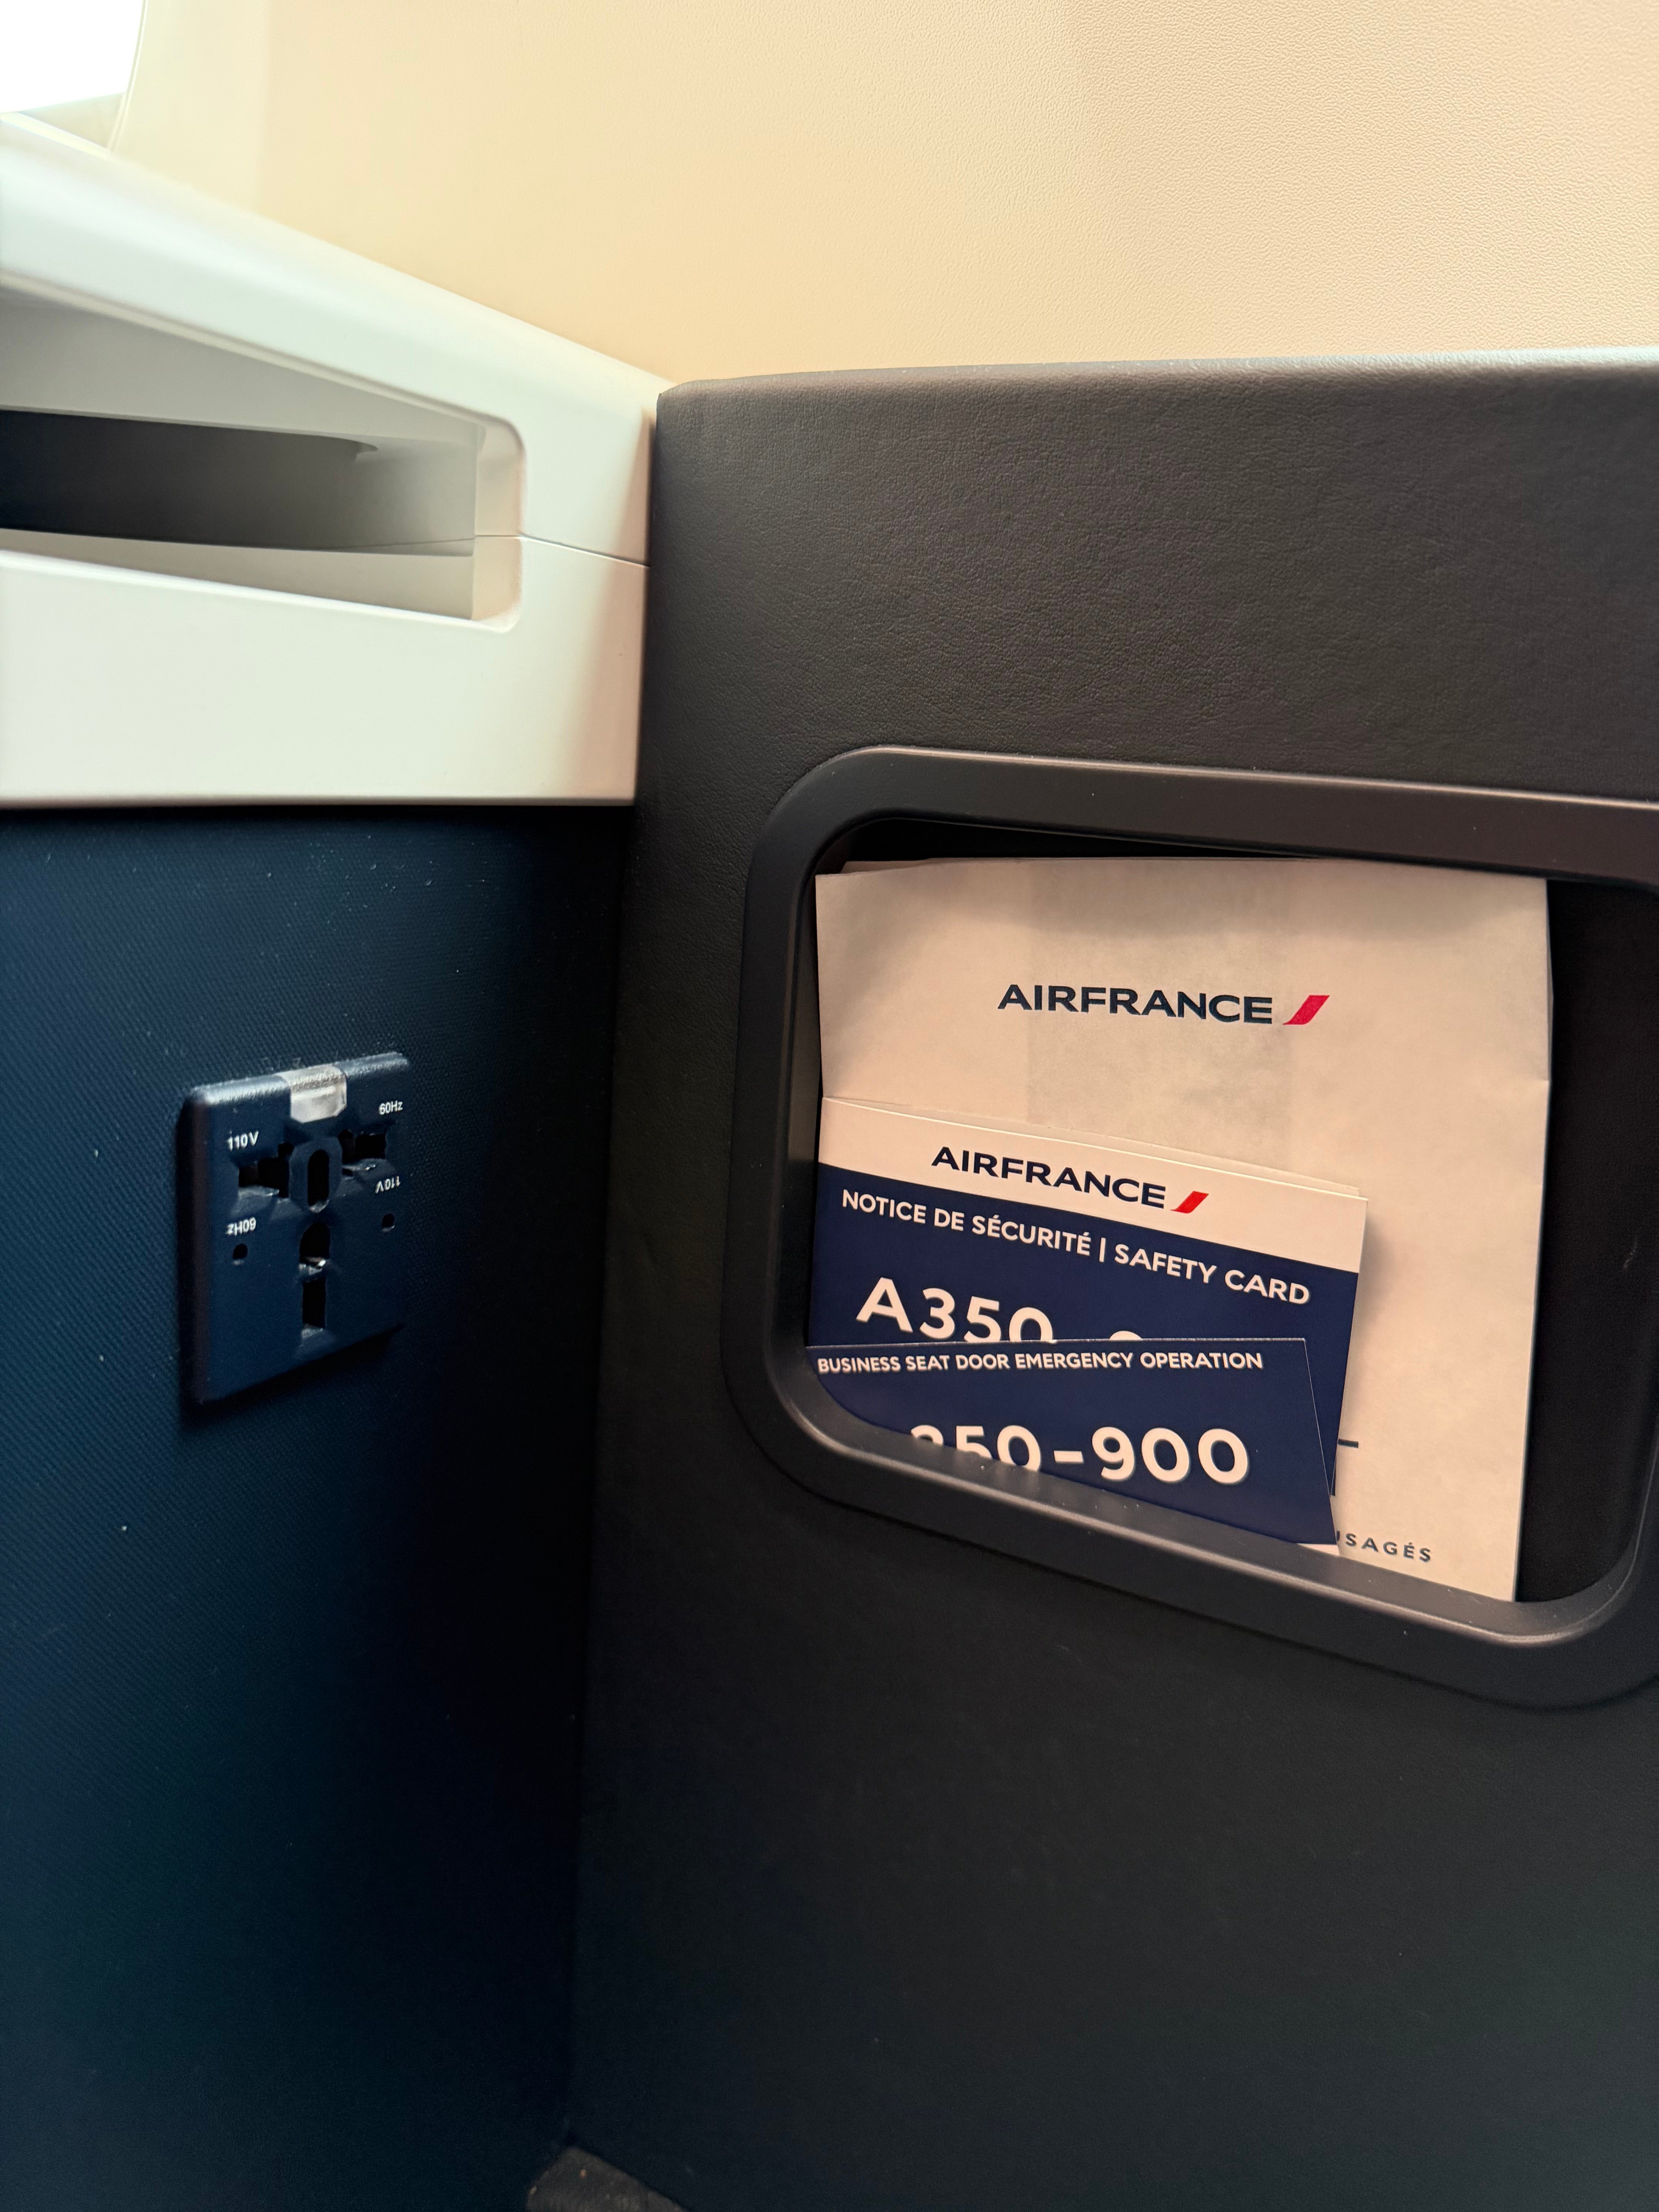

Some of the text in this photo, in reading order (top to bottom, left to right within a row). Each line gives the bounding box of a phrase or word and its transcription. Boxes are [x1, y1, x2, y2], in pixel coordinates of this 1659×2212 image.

[997, 984, 1273, 1025] AIRFRANCE
[378, 1100, 404, 1116] 60Hz
[227, 1130, 259, 1151] 110V
[375, 1175, 401, 1194] 110V
[931, 1146, 1166, 1209] AIRFRANCE
[226, 1216, 257, 1237] 60Hz
[842, 1189, 927, 1224] NOTICE
[934, 1207, 965, 1231] DE
[972, 1214, 1091, 1256] SÉCURITÉ
[1114, 1243, 1217, 1284] SAFETY
[1224, 1269, 1310, 1304] CARD
[817, 1352, 1263, 1374] BUSINESS SEAT DOOR EMERGENCY OPERATION
